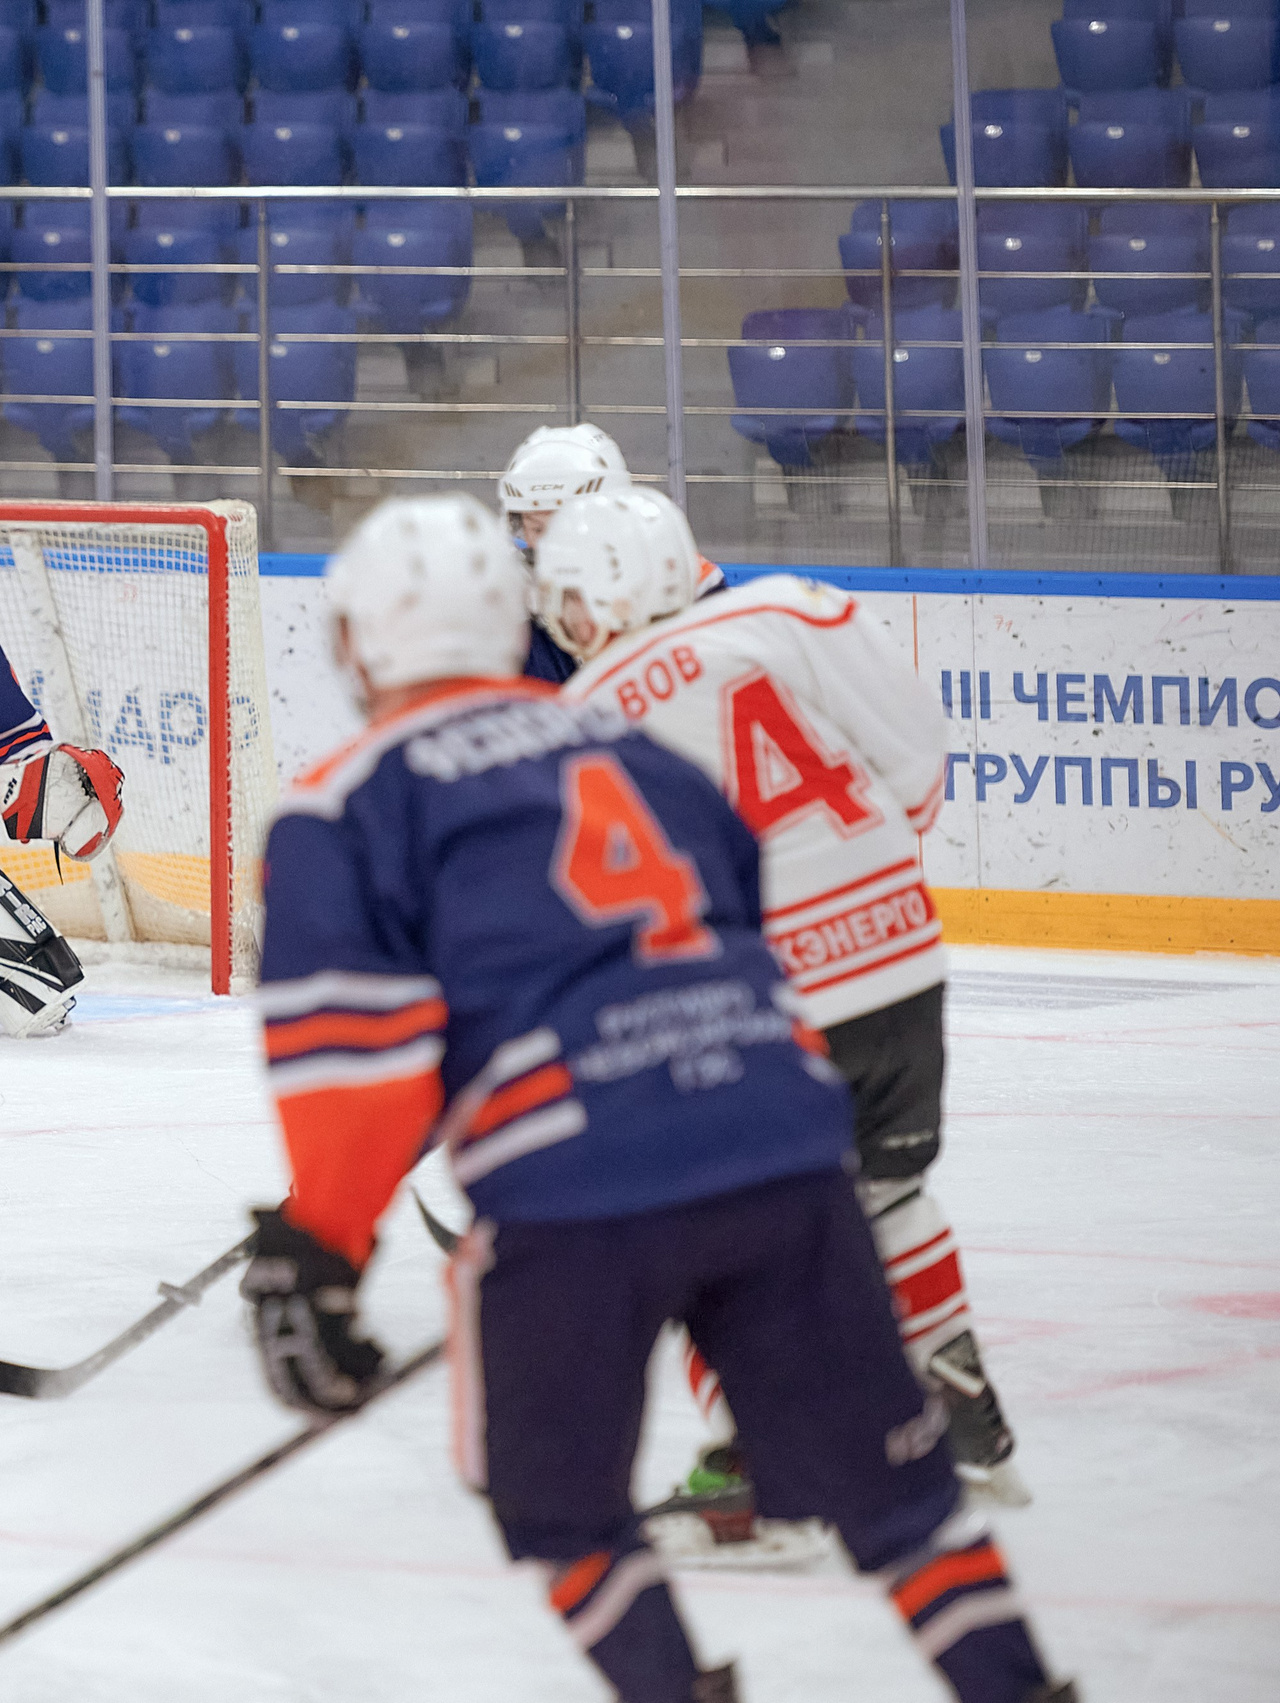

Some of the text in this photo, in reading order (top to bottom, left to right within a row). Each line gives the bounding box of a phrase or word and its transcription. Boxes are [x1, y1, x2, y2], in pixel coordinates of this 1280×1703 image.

[721, 666, 882, 838] 4
[944, 752, 1198, 810] ГРУППЫ
[551, 753, 719, 963] 4
